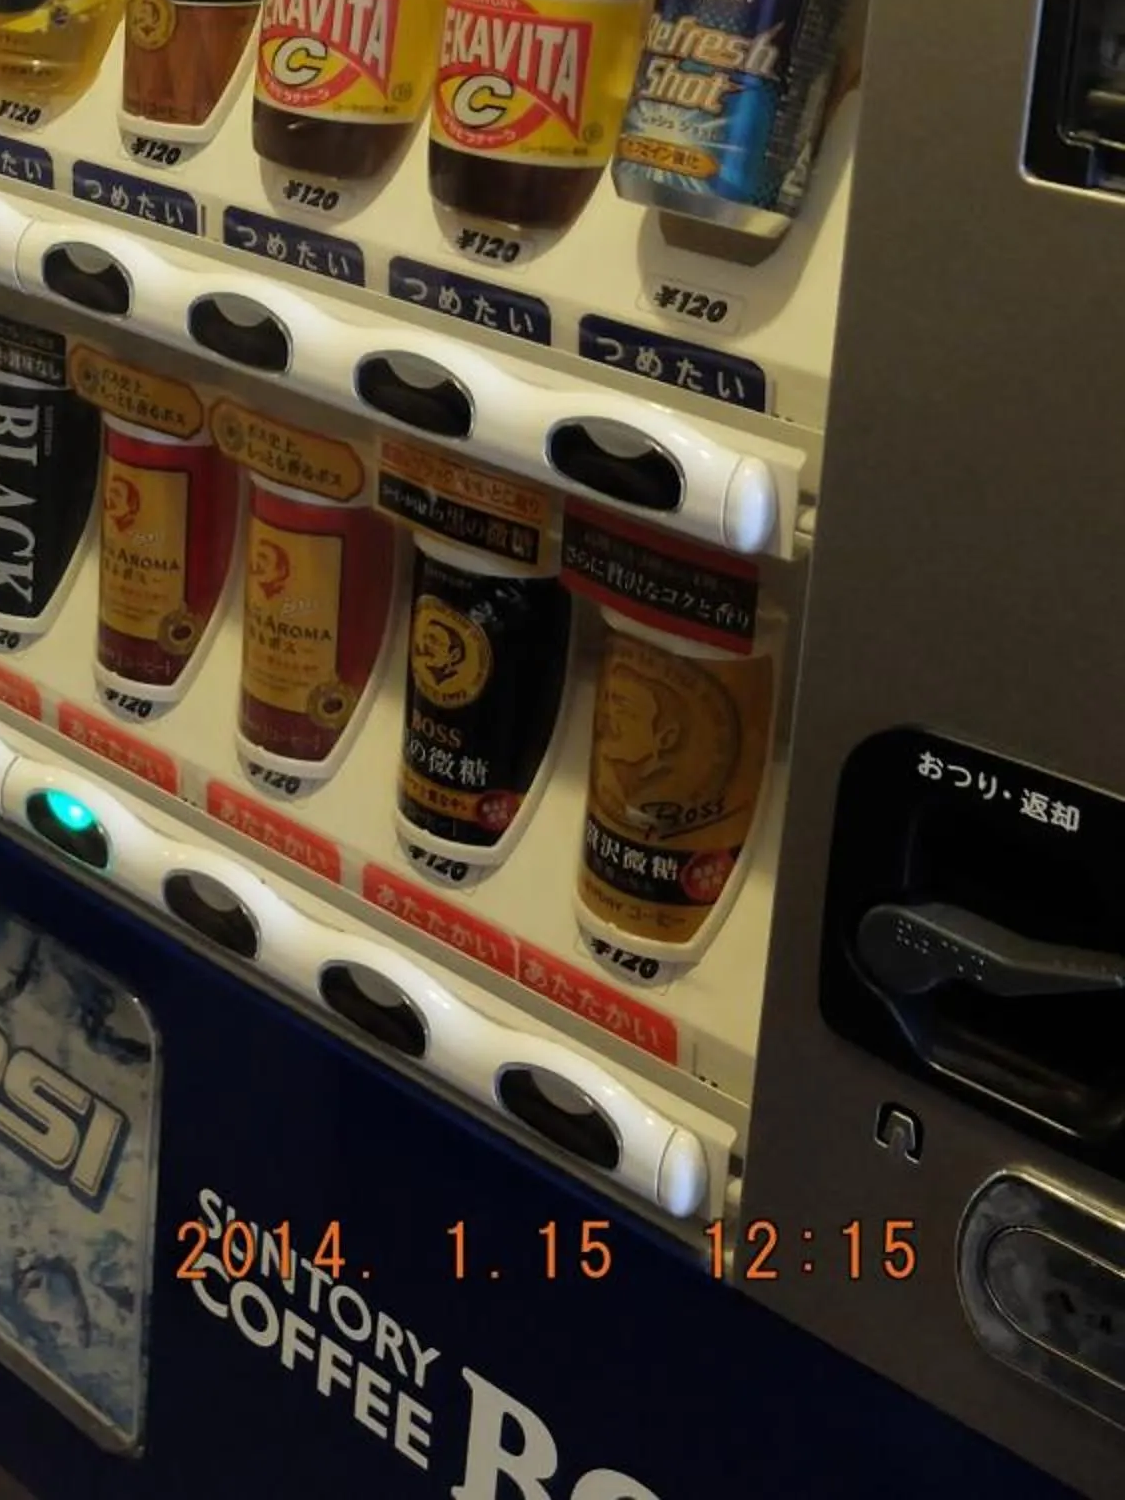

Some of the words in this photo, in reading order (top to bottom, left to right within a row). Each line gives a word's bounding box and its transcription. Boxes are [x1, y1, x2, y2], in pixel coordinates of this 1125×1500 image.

[271, 36, 328, 87] C
[452, 71, 516, 129] C
[131, 137, 182, 166] ¥120
[84, 178, 185, 225] つめたい
[283, 179, 340, 212] ¥120
[236, 225, 351, 276] つめたい
[456, 228, 521, 263] ¥120
[403, 276, 535, 334] つめたい
[654, 284, 728, 324] ¥120
[594, 337, 746, 399] つめたい
[105, 688, 153, 719] ¥120
[248, 762, 301, 795] ¥120
[917, 750, 1081, 833] おつり・返却
[408, 845, 470, 881] ¥120
[376, 882, 500, 961] あたたかい
[590, 936, 660, 979] ¥120
[525, 959, 660, 1048] あたたかい
[197, 1187, 441, 1389] SUNTORY
[191, 1251, 434, 1471] COFFEE
